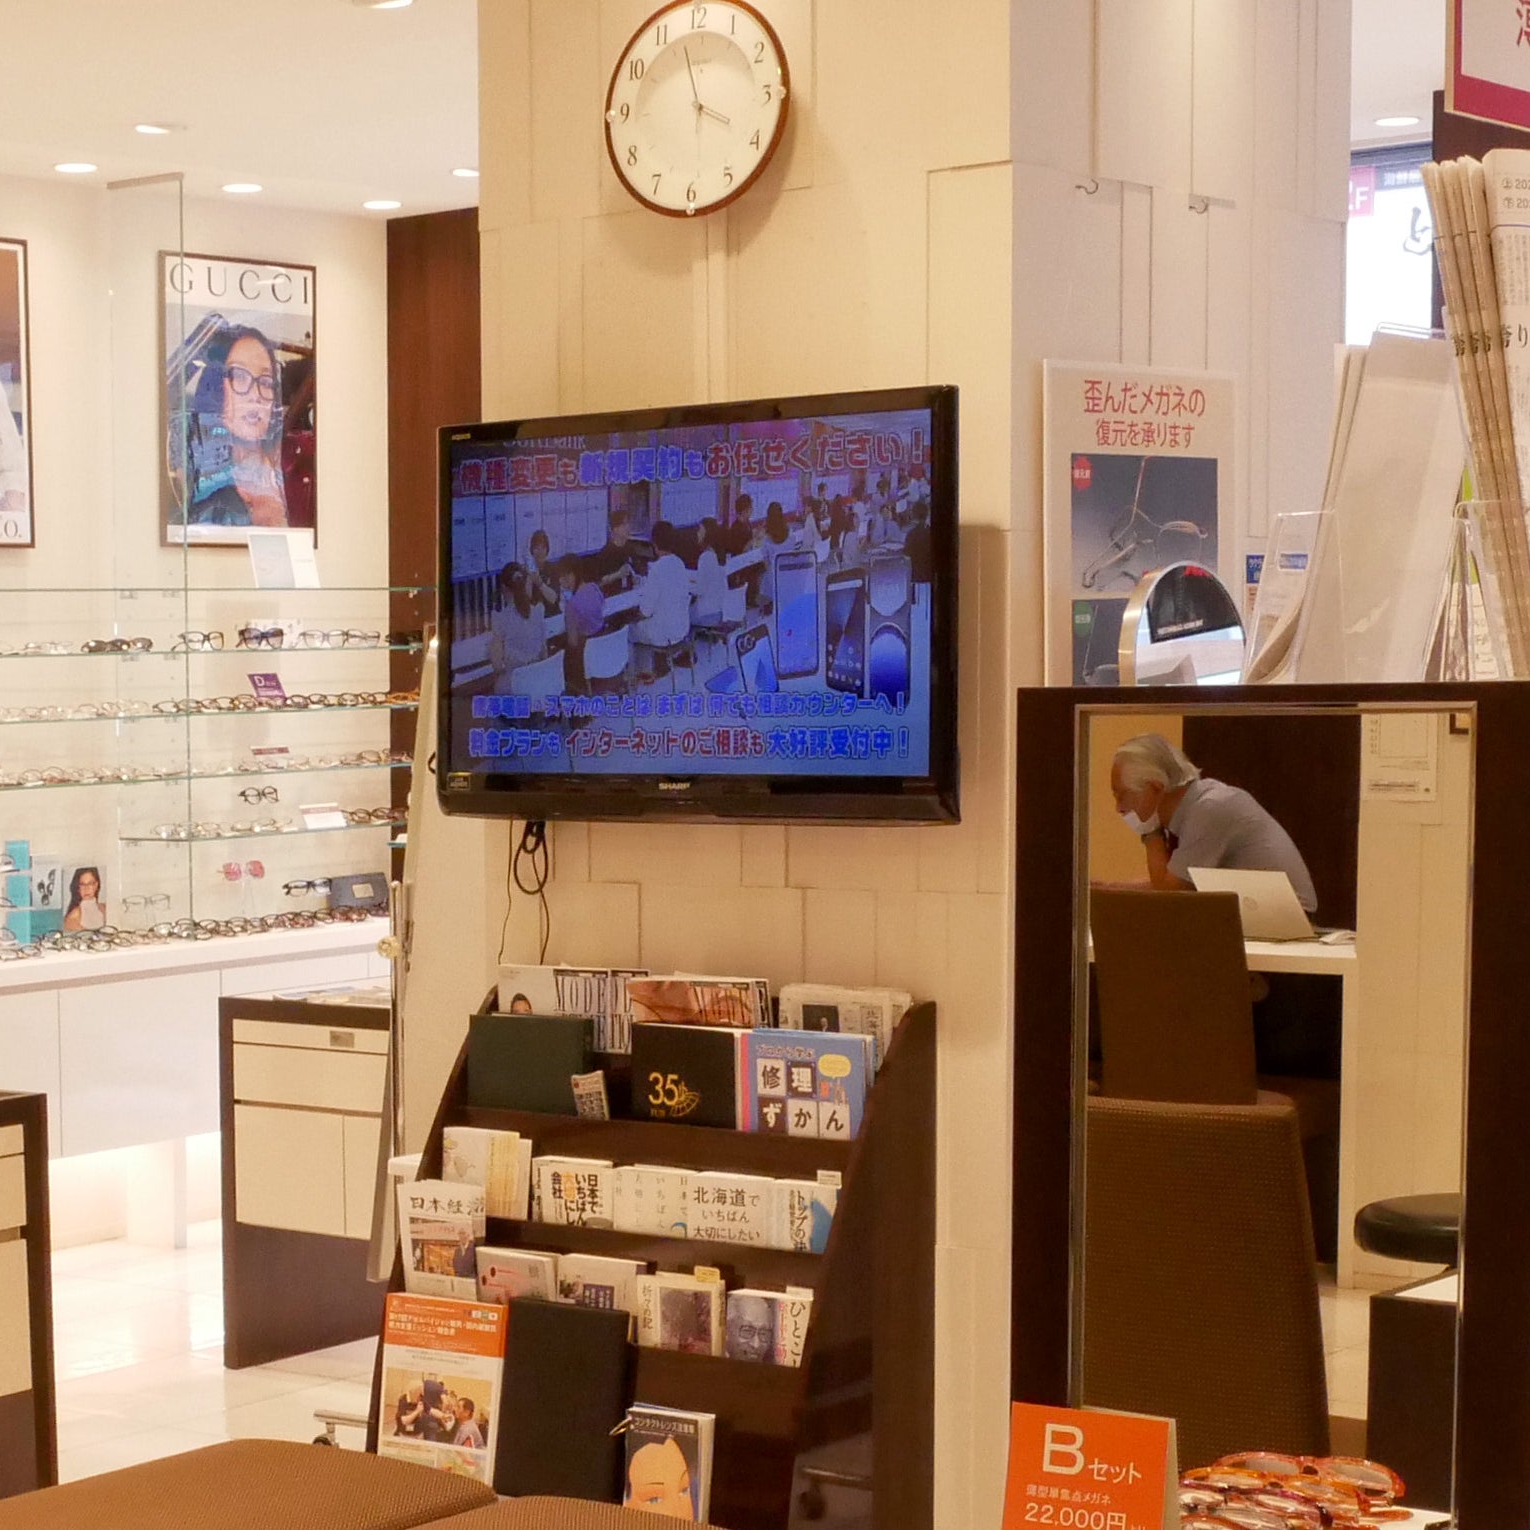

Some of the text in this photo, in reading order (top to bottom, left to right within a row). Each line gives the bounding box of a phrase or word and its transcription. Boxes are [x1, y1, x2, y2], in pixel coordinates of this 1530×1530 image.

[690, 7, 708, 30] 12
[730, 14, 736, 35] 1
[655, 24, 669, 46] 11
[754, 41, 765, 63] 2
[629, 58, 645, 81] 10
[761, 84, 772, 106] 3
[620, 103, 630, 124] 9
[749, 129, 760, 151] 4
[627, 145, 637, 166] 8
[652, 174, 662, 196] 7
[723, 166, 733, 187] 5
[686, 181, 697, 202] 6
[169, 262, 308, 305] GUCCI
[1083, 378, 1206, 417] 歪んだメガネの
[1095, 419, 1195, 448] 復元を承ります
[761, 1063, 814, 1094] 修理
[762, 1102, 845, 1133] ずかん
[551, 1172, 564, 1199] 会社
[587, 1173, 599, 1212] 日本で
[693, 1187, 760, 1207] 北海道で
[702, 1209, 750, 1223] いちばん
[693, 1227, 760, 1242] 大切にしたい
[1042, 1423, 1142, 1485] Bセット
